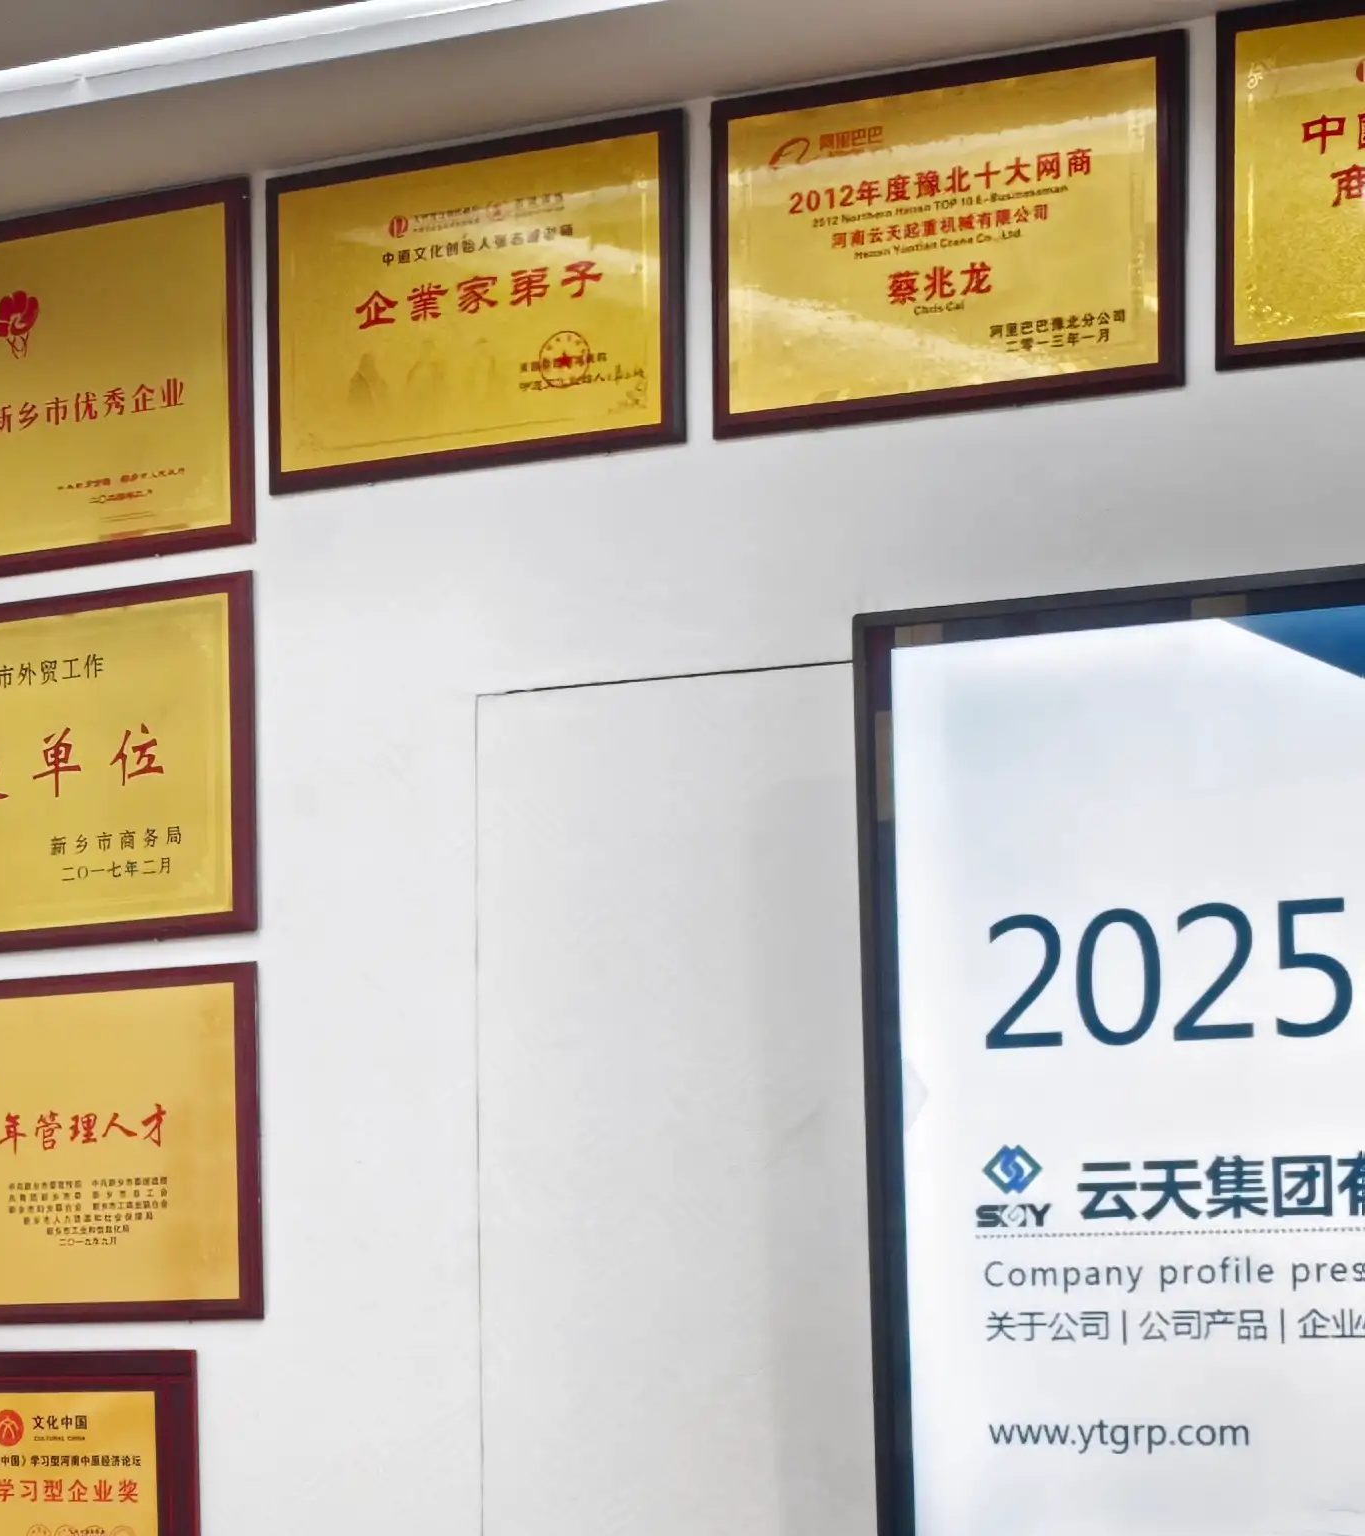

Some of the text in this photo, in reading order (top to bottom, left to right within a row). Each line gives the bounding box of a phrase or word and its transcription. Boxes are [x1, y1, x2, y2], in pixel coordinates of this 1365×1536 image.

[1302, 113, 1365, 155] 中
[789, 148, 1092, 216] 2012年度豫北十大网商
[933, 199, 957, 211] TOP
[355, 260, 604, 330] 企業家弟子
[887, 261, 993, 306] 蔡兆龙
[990, 308, 1126, 339] 阿里巴巴豫北分公司
[1006, 328, 1111, 352] 二零一三年一月
[50, 825, 183, 857] 新乡市商务局
[986, 897, 1353, 1049] 2025
[984, 1260, 1143, 1294] Company
[1160, 1256, 1276, 1293] profile
[986, 1310, 1109, 1343] 关于公司
[1139, 1309, 1268, 1342] 公司产品
[31, 1414, 88, 1430] 文化中国
[988, 1418, 1251, 1454] www.ytgrp.com
